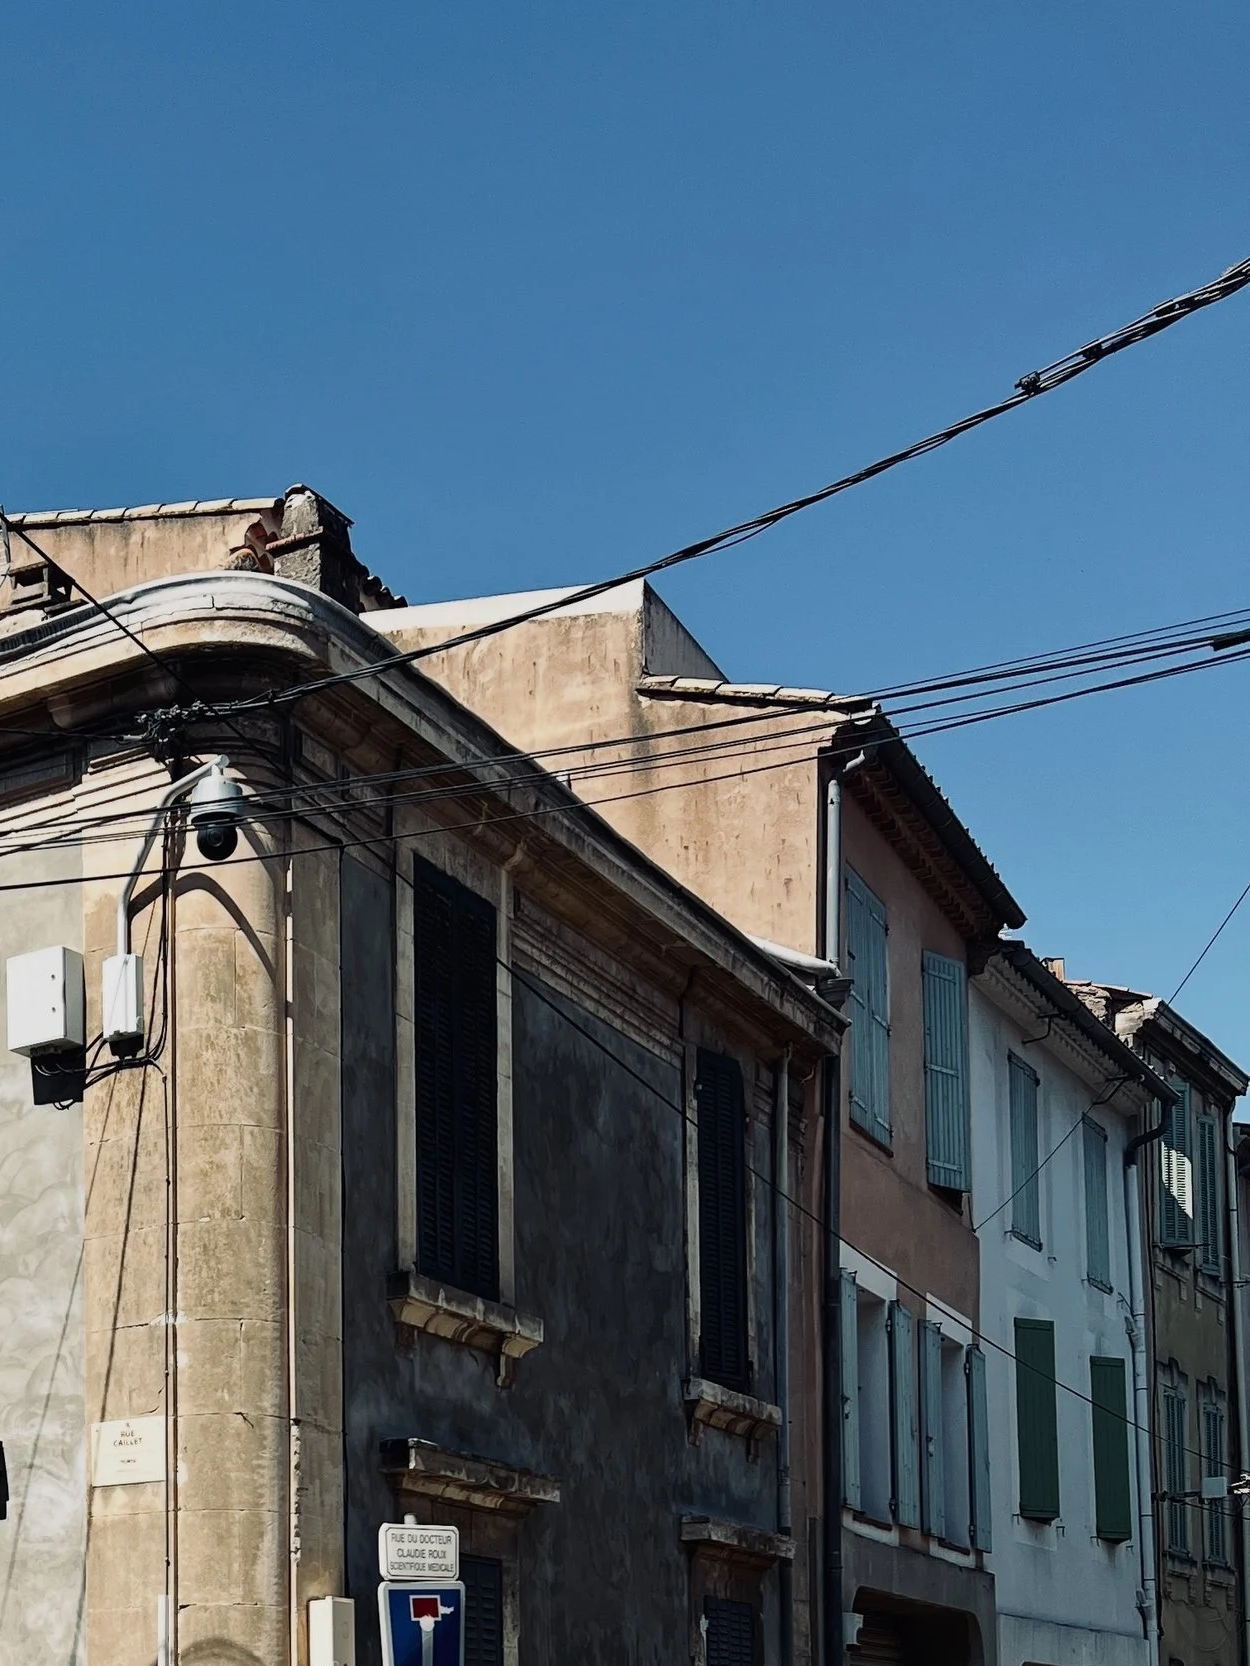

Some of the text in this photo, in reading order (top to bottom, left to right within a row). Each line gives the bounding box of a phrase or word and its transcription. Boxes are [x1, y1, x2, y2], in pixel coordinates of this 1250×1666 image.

[121, 1430, 134, 1438] RUE
[391, 1533, 452, 1544] RUE DU DOCTEUR
[428, 1550, 446, 1559] ROUX
